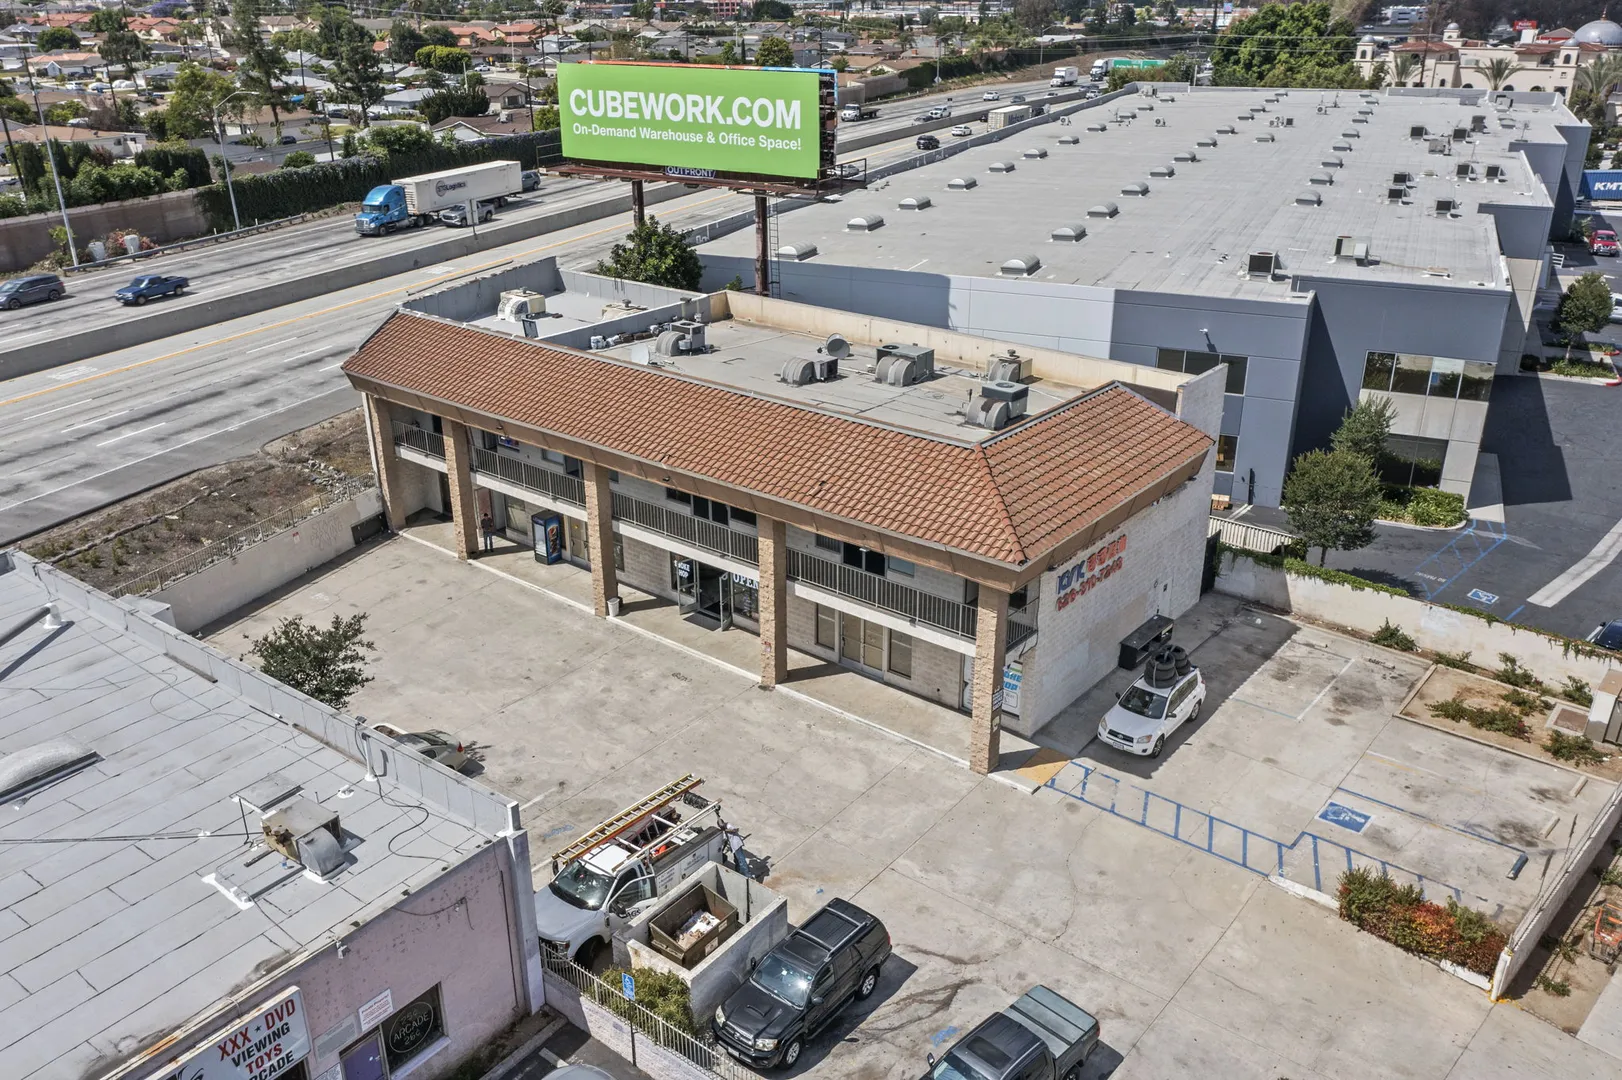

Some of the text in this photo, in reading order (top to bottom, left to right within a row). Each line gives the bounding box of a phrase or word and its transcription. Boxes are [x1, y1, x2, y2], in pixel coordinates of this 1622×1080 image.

[569, 88, 801, 130] CUBEWORK.COM
[573, 122, 802, 151] On-Demand Warehouse & Office Space!
[667, 165, 713, 177] OUTFRONT
[732, 573, 759, 590] OPEN
[217, 1026, 252, 1061] XXX
[264, 998, 296, 1031] DVD
[393, 1011, 430, 1044] ARCADE
[231, 1021, 290, 1068] VIEWING
[245, 1043, 283, 1075] TOYS
